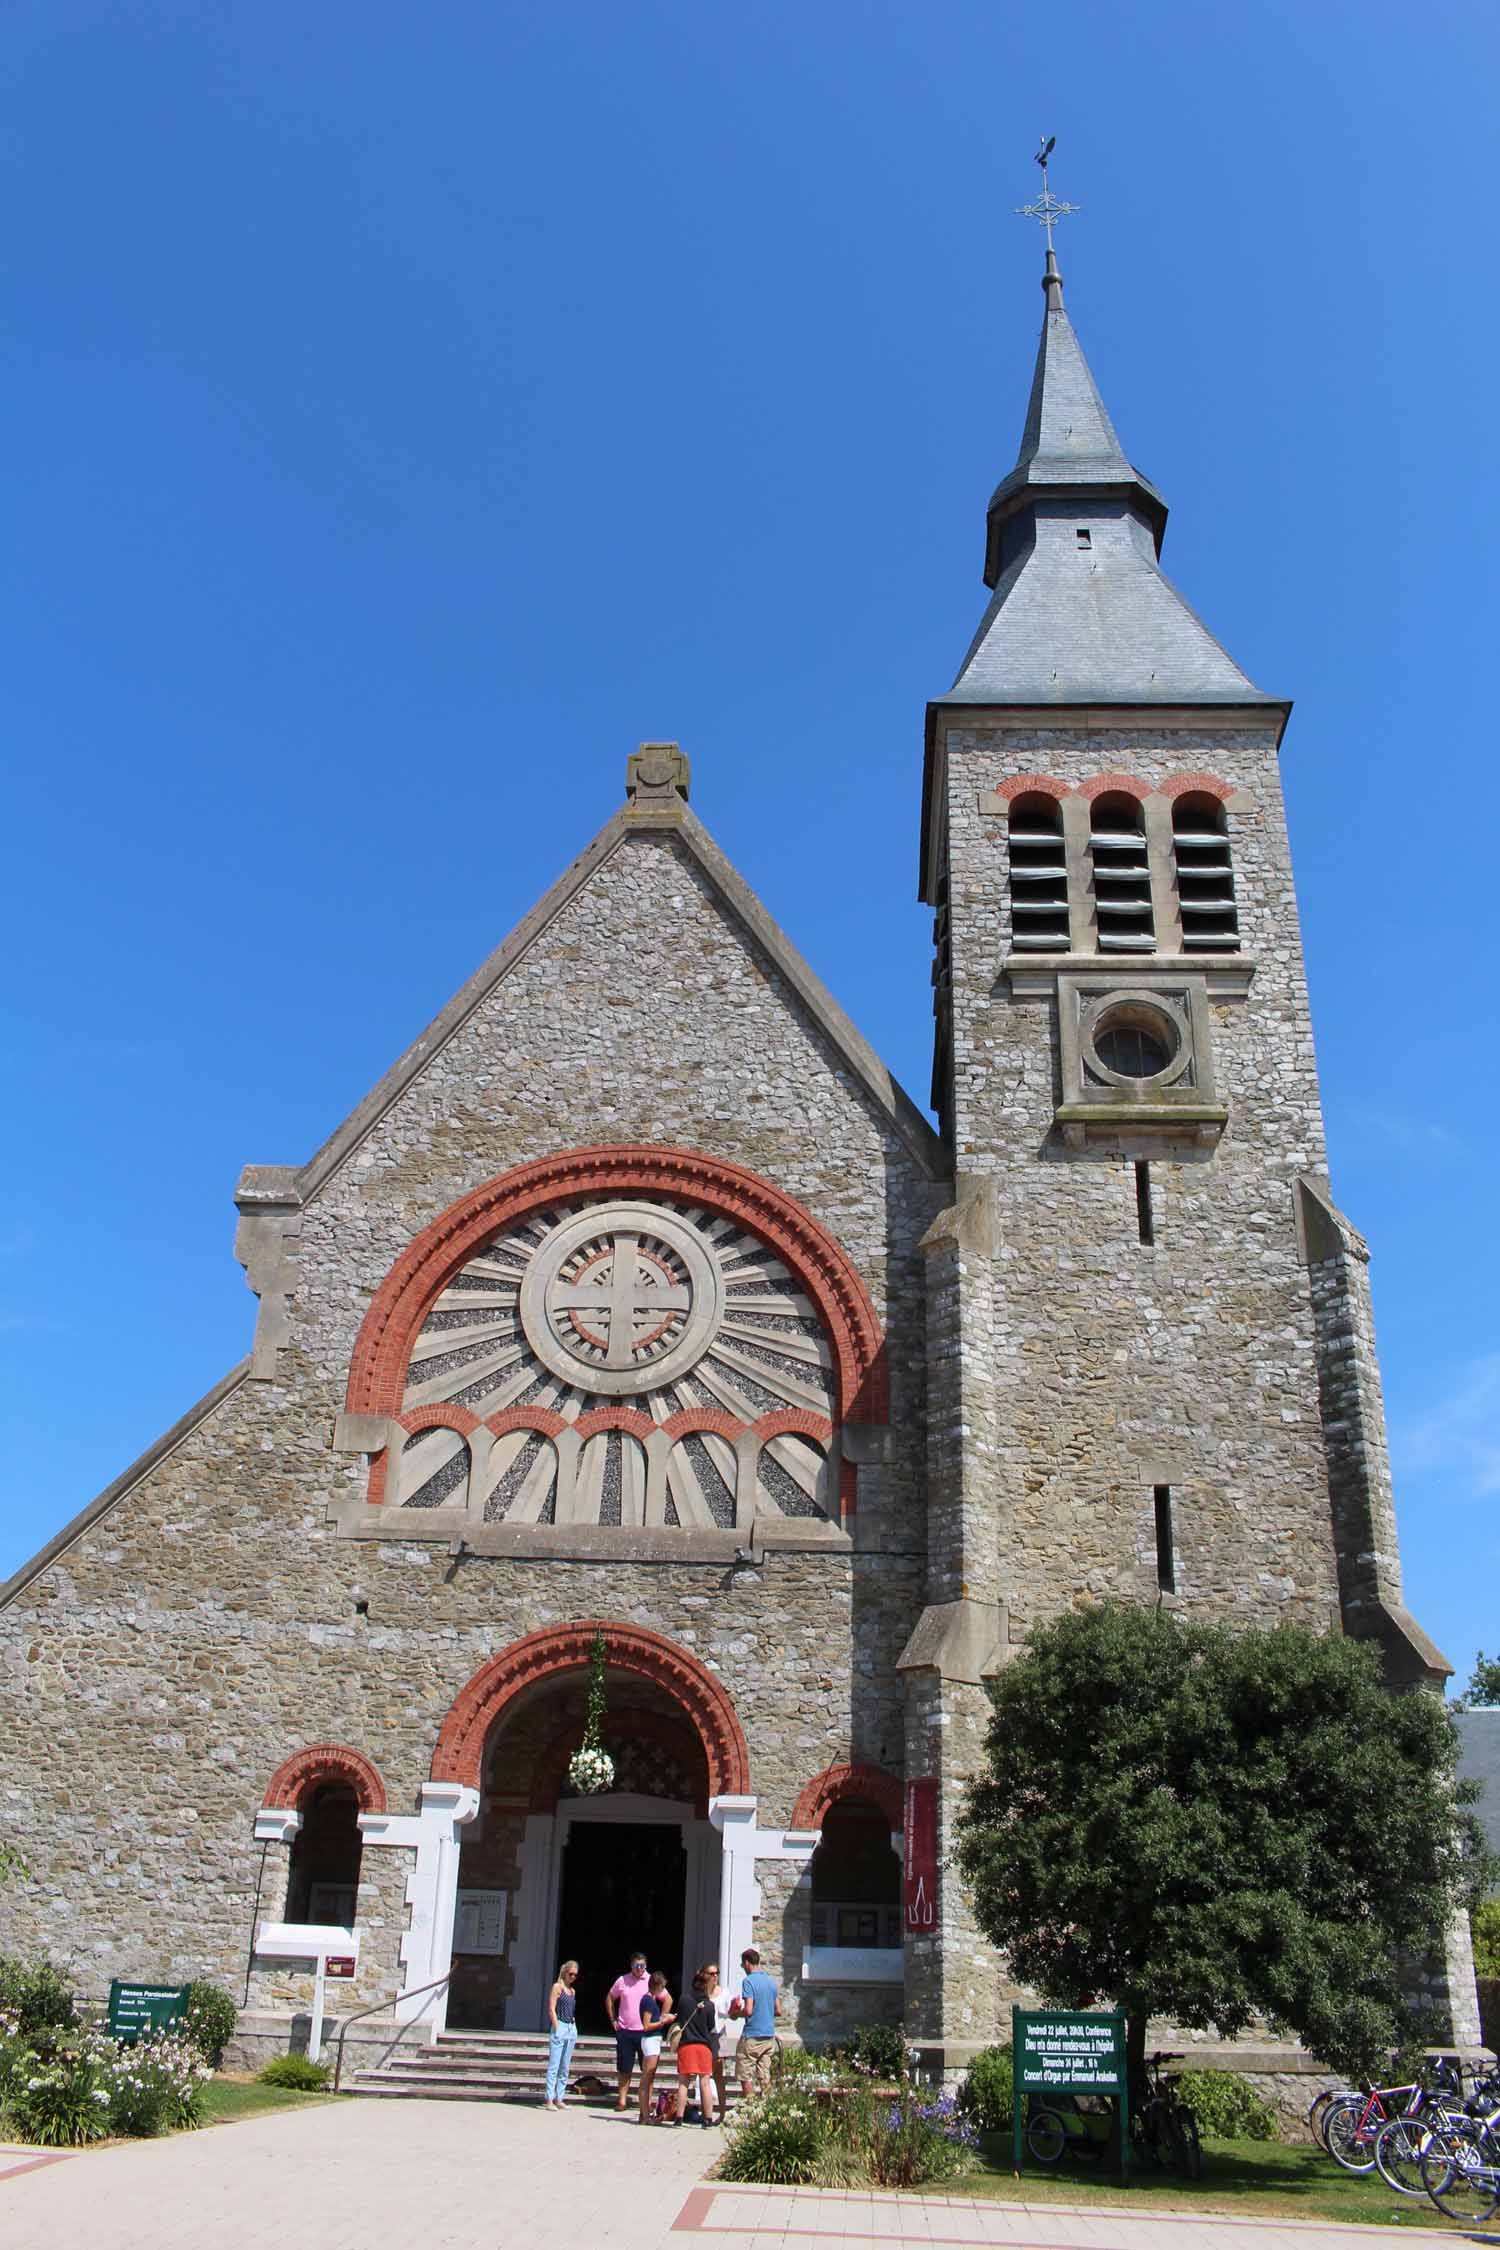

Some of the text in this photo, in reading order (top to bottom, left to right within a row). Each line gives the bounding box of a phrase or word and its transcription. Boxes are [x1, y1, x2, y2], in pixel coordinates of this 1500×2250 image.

[1026, 2024, 1047, 2036] Vendredi
[1048, 2025, 1054, 2036] 22
[1025, 2038, 1036, 2050] Dieu
[1046, 2038, 1061, 2051] donné
[1062, 2040, 1090, 2051] rendez-vous
[1042, 2057, 1065, 2068] Dimanche
[1024, 2069, 1043, 2081] Concert
[1043, 2069, 1061, 2084] d'Orgue
[1062, 2072, 1070, 2084] par
[1071, 2070, 1095, 2082] Emmanuel
